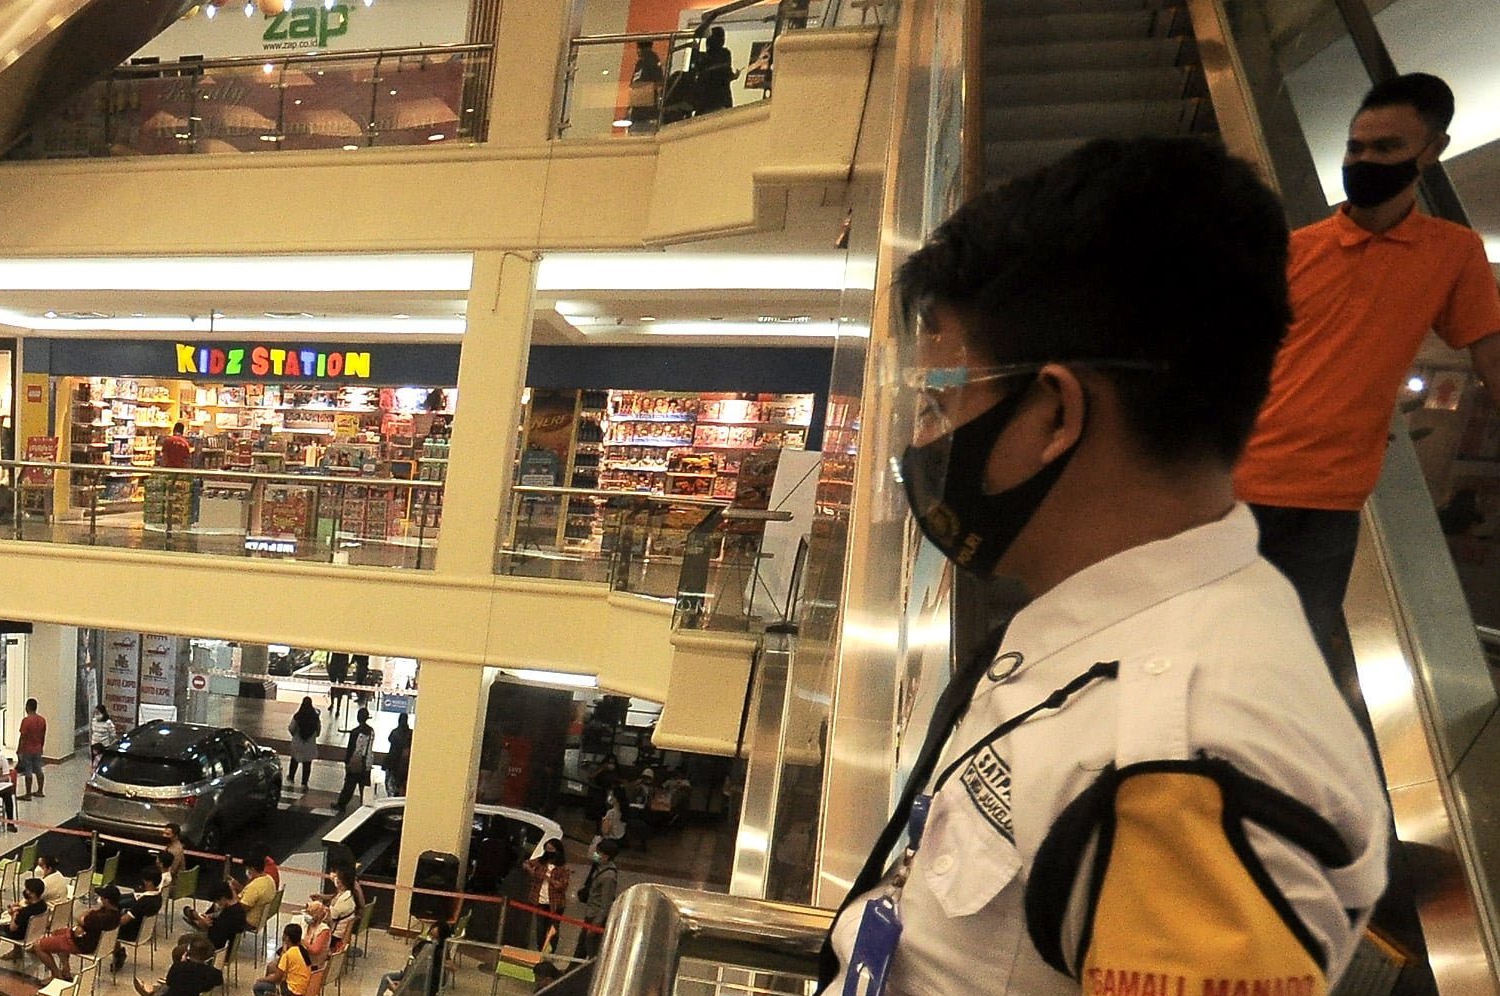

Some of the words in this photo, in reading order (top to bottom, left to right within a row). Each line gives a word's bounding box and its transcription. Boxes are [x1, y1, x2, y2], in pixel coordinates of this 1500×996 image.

[263, 4, 349, 48] zap
[263, 39, 318, 51] www.zap.co.id
[176, 343, 245, 375] KIDZ
[251, 346, 371, 378] STATION
